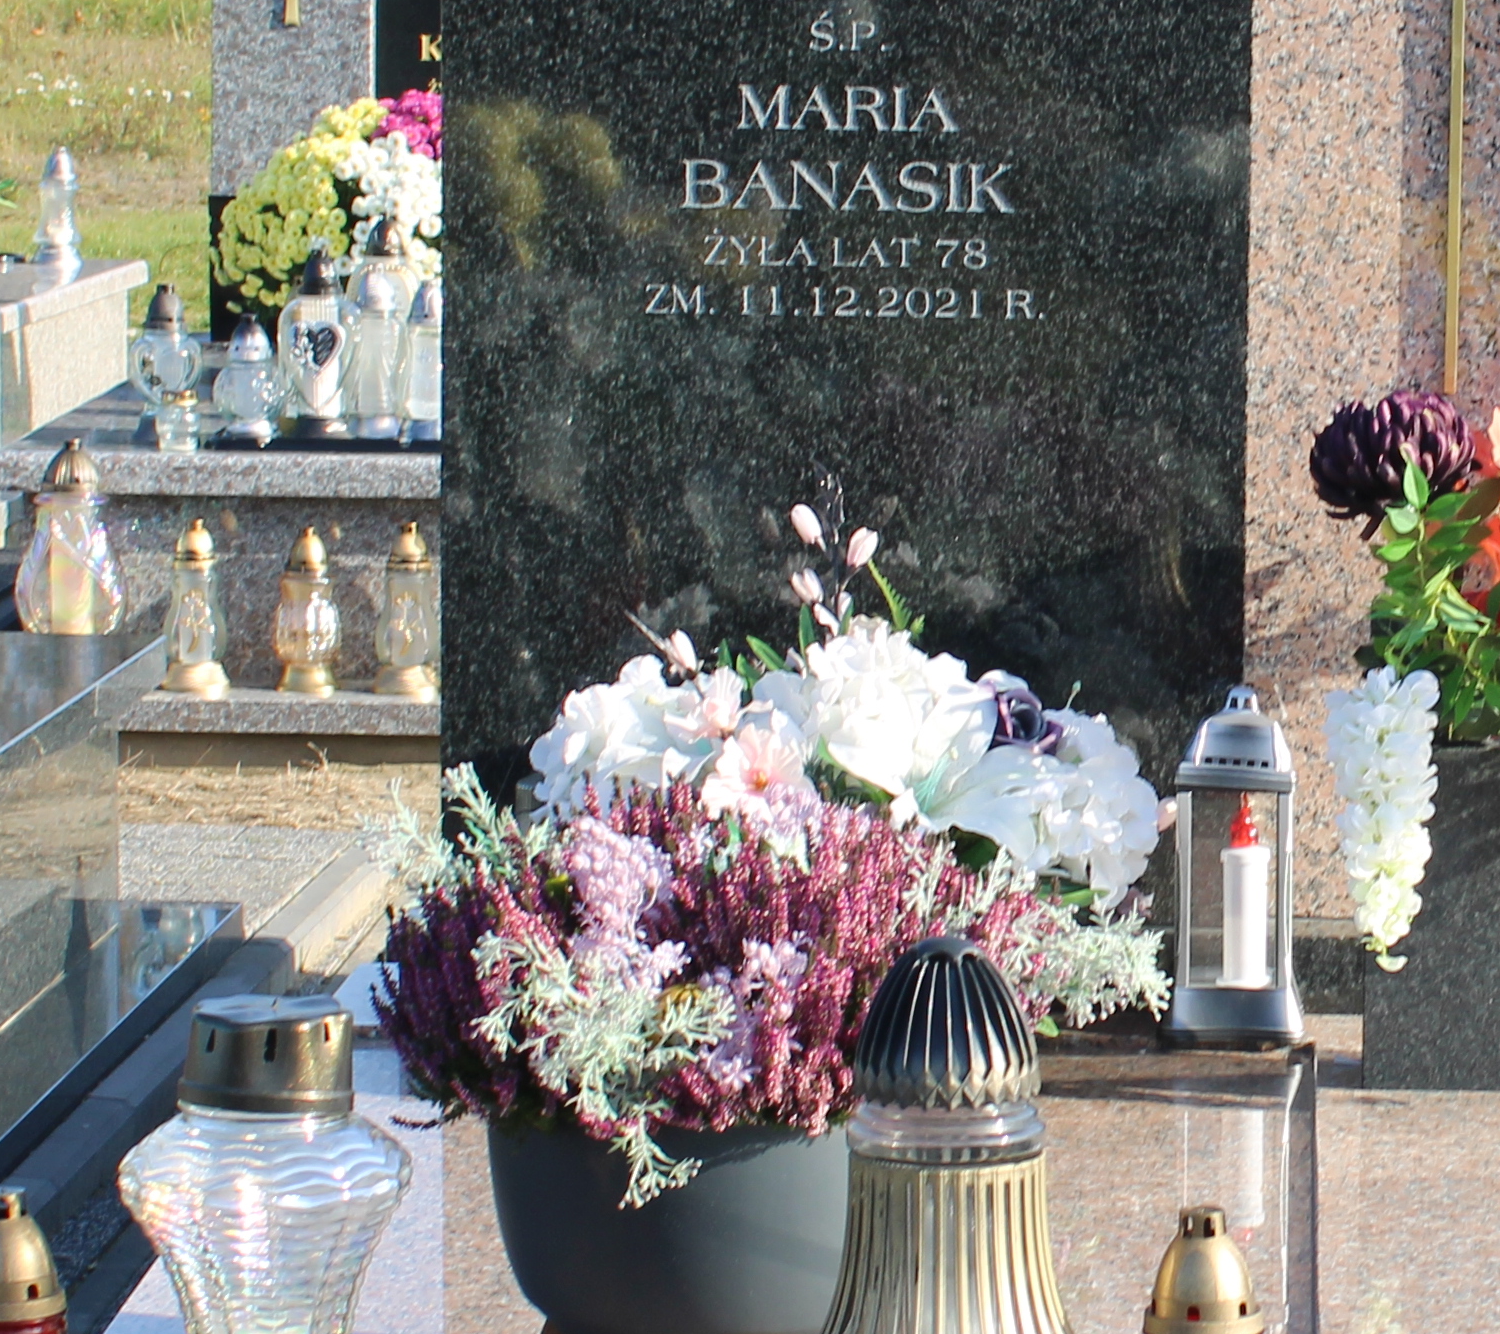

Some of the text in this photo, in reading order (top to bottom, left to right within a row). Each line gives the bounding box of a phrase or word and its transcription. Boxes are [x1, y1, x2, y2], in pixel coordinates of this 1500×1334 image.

[810, 10, 892, 52] Ś.P.
[737, 84, 959, 133] MARIA
[680, 158, 1015, 213] BANASIK
[704, 228, 987, 269] ŻYŁA LAT 78
[644, 283, 1047, 321] ZM. 11.12.2021 R.
